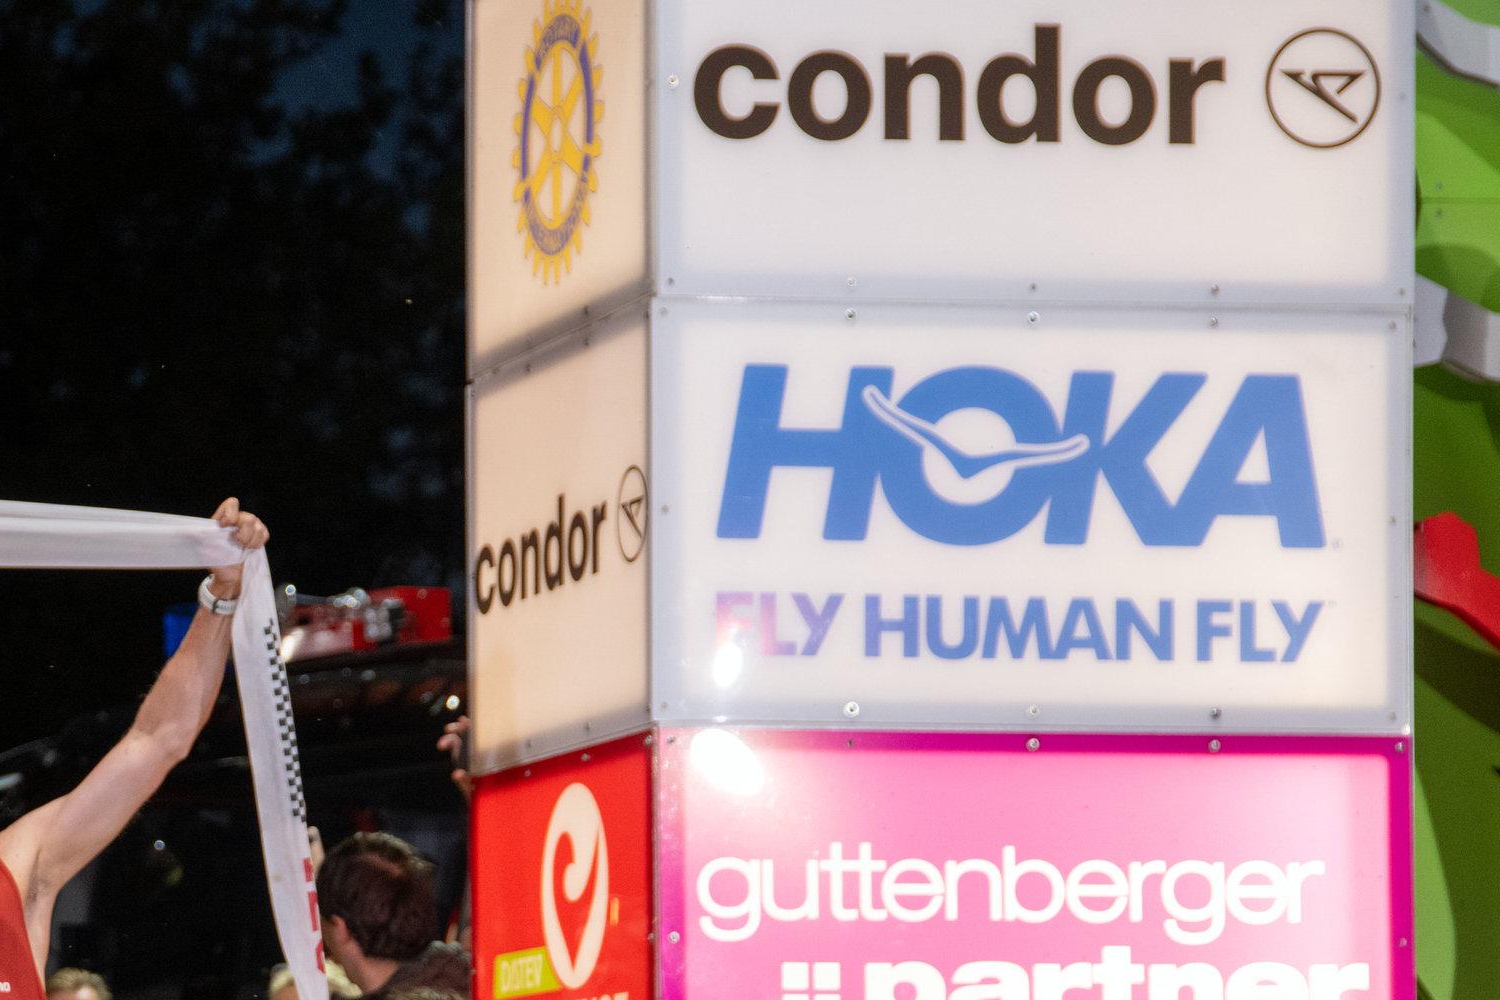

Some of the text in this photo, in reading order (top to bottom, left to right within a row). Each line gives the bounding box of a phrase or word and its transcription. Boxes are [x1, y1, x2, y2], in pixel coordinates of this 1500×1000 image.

[693, 24, 1226, 146] condor
[716, 363, 1327, 548] HOKA
[476, 492, 607, 615] condor
[715, 592, 1323, 662] FLY HUMAN FLY
[696, 841, 1325, 946] guttenberger
[500, 953, 543, 994] DATEV
